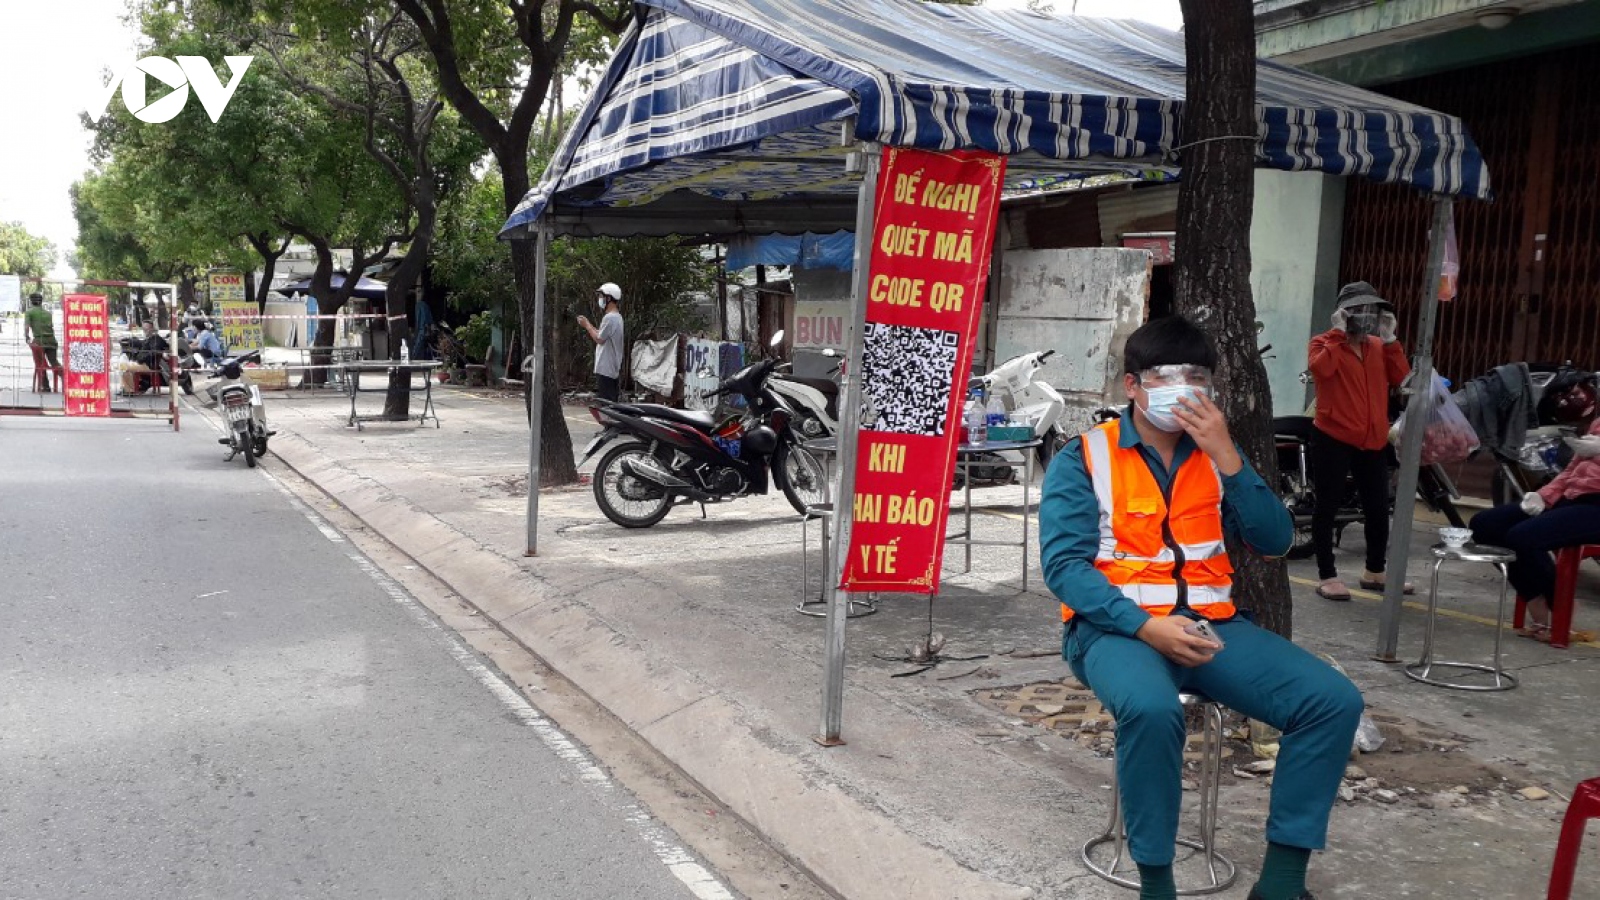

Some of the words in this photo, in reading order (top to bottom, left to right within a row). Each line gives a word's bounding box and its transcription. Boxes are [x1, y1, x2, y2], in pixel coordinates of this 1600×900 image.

[921, 179, 981, 221] NGHỊ
[880, 221, 929, 257] QUÉT
[932, 229, 974, 264] MÃ
[870, 274, 925, 308] CODE
[929, 281, 965, 313] QR
[69, 329, 90, 338] CODE
[796, 307, 843, 345] BÚN
[868, 442, 907, 474] KHI
[852, 493, 882, 523] HAI
[886, 490, 935, 526] BÁO
[860, 545, 872, 574] Y
[875, 536, 902, 574] TẾ
